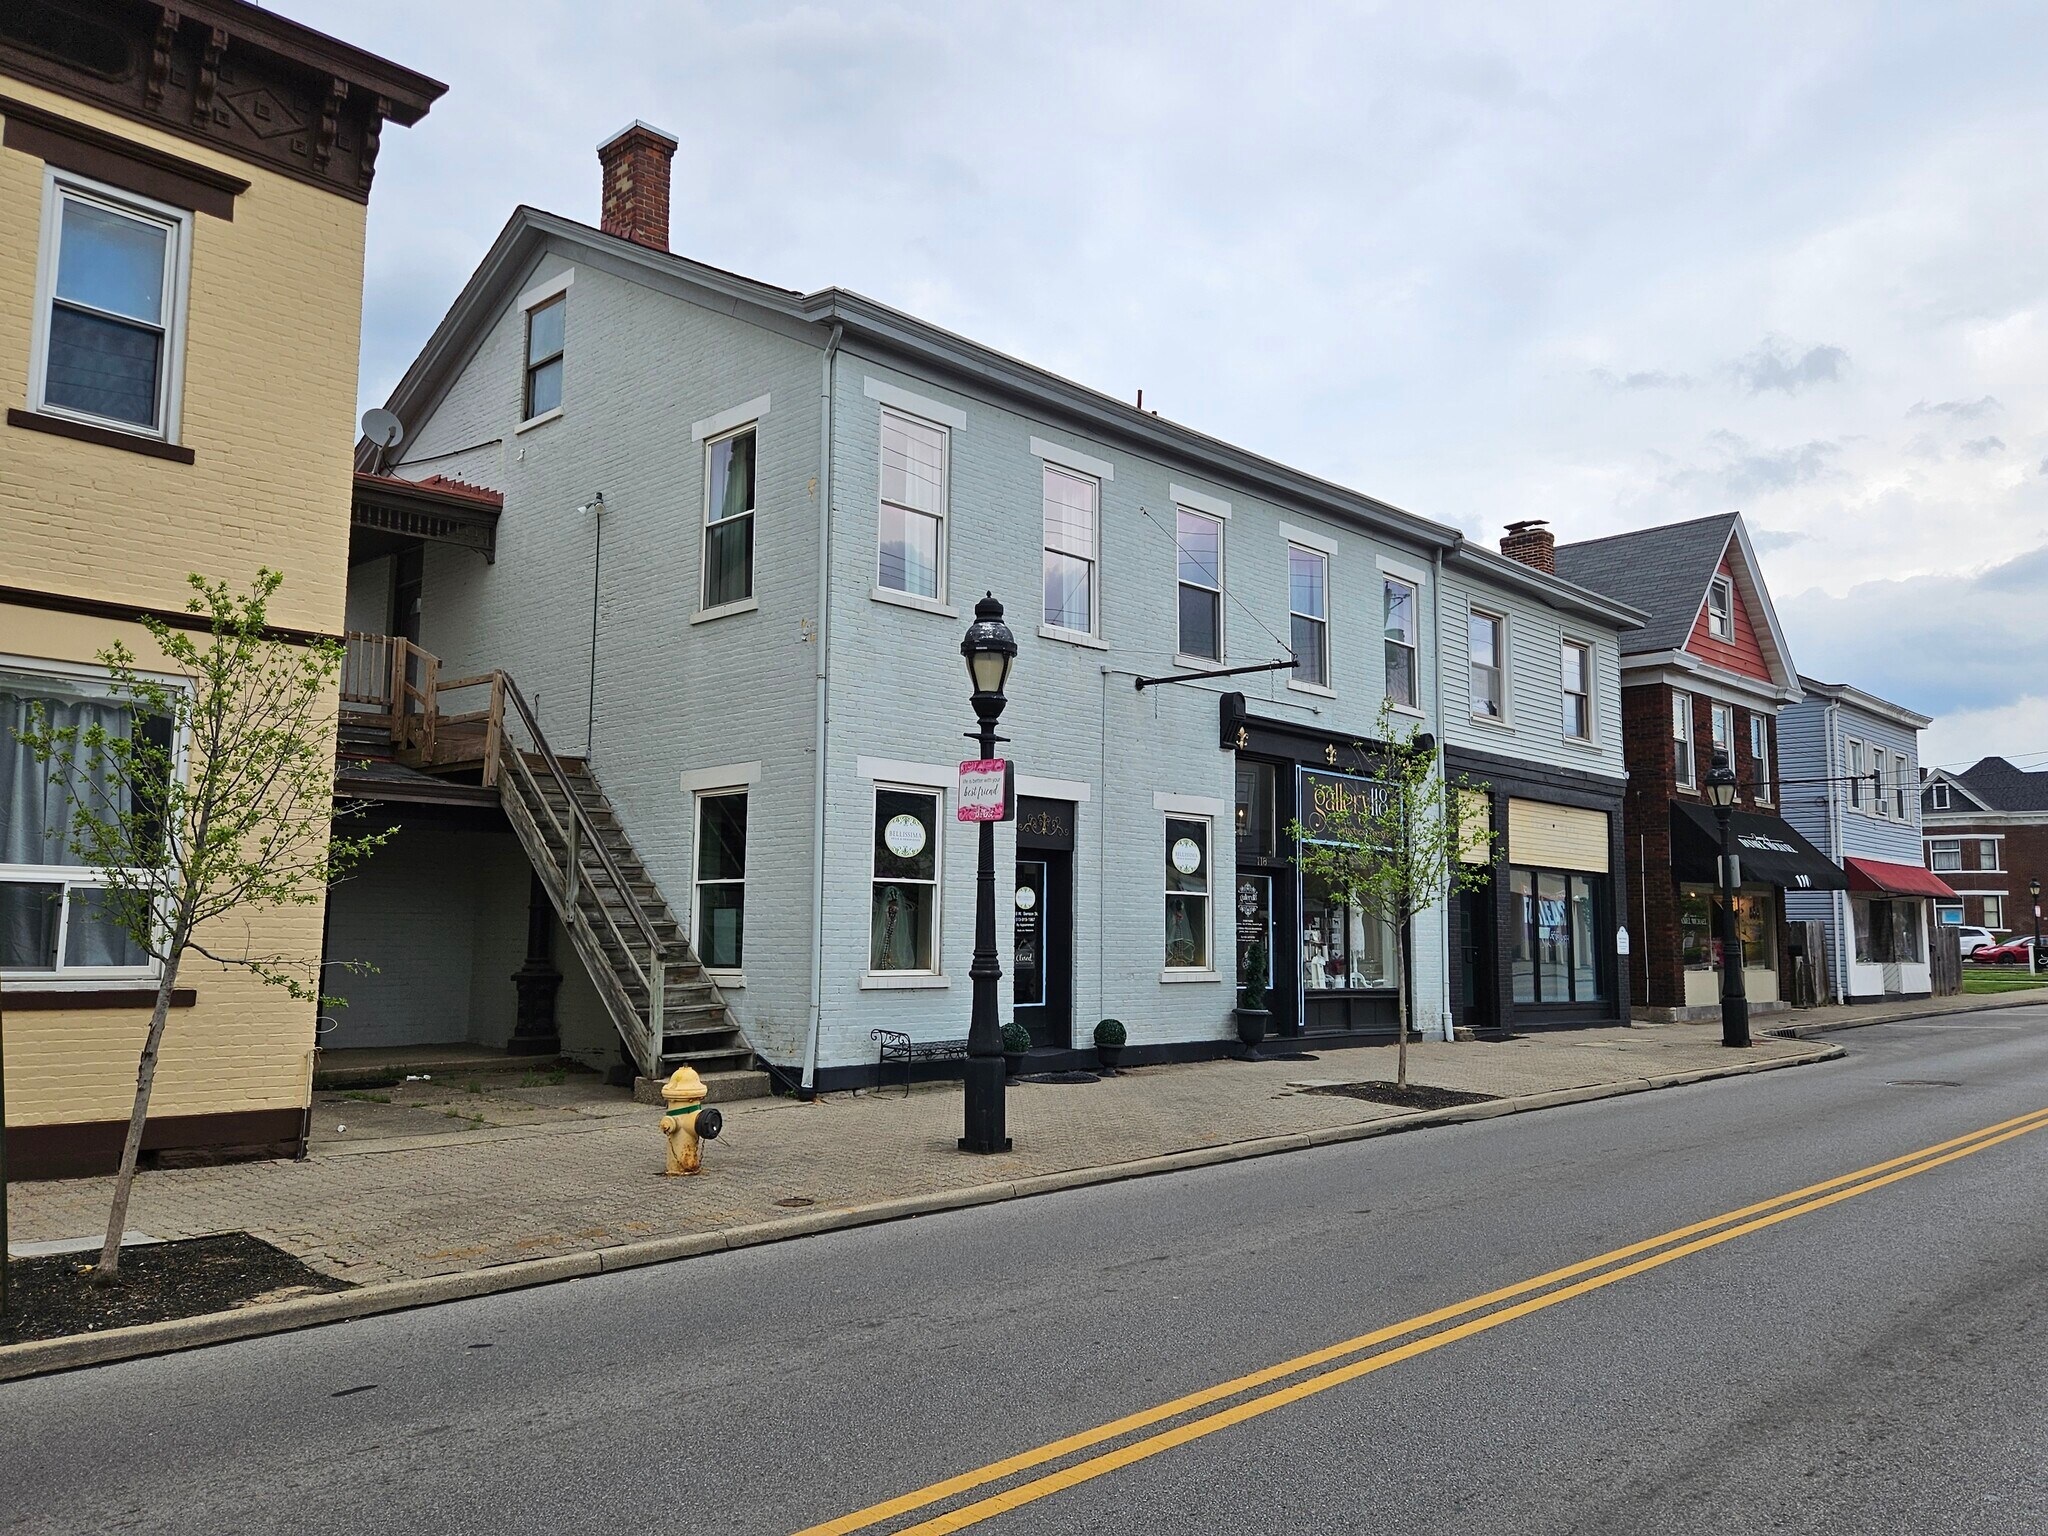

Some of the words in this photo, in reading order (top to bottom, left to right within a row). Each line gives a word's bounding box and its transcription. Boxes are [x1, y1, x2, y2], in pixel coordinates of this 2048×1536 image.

[964, 786, 977, 797] best
[977, 783, 999, 799] friend
[889, 830, 922, 838] BELLISSIMA
[1257, 856, 1268, 866] 118
[1795, 874, 1812, 888] 110
